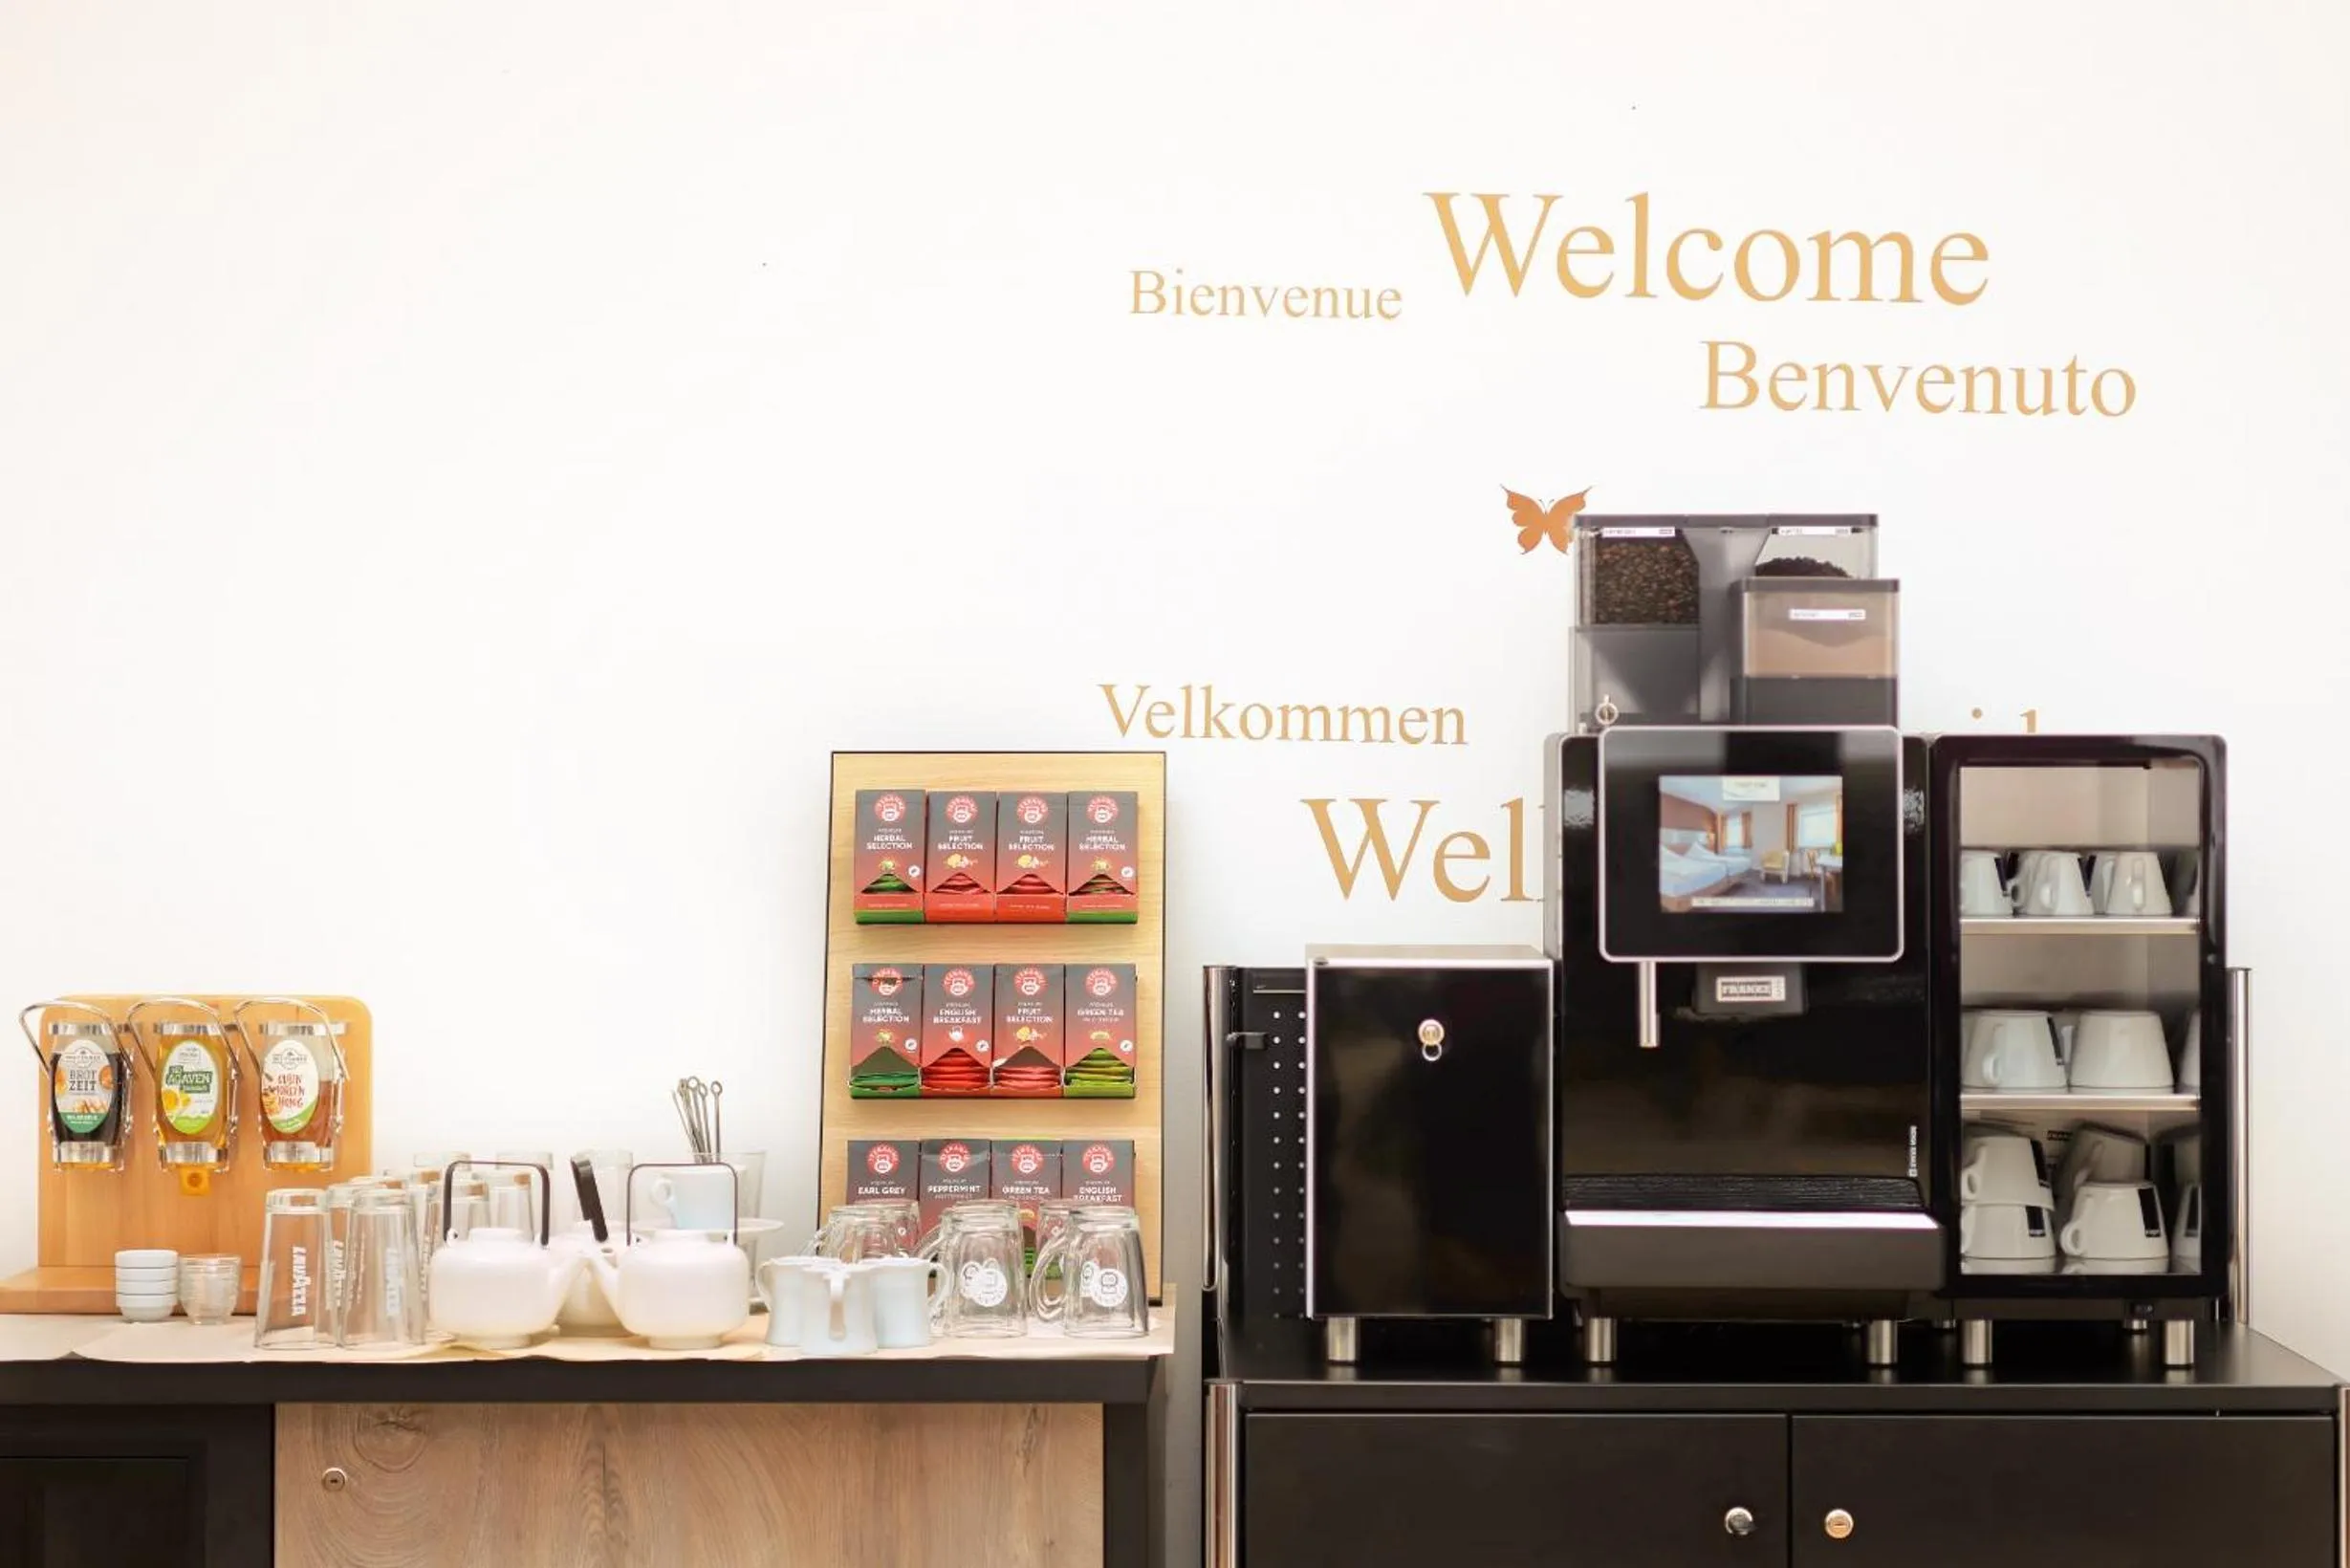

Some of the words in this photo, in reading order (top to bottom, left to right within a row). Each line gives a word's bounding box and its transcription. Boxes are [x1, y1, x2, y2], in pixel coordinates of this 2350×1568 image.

[1422, 190, 1991, 308] Welcome
[1129, 269, 1403, 322] Bienvenue
[1698, 340, 2138, 417] Benvenuto
[1099, 683, 1469, 748] Velkommen
[1300, 797, 1546, 903] Wel
[69, 1080, 97, 1091] ZEIT
[70, 1070, 97, 1079] BROT
[166, 1072, 211, 1084] AGAVEN
